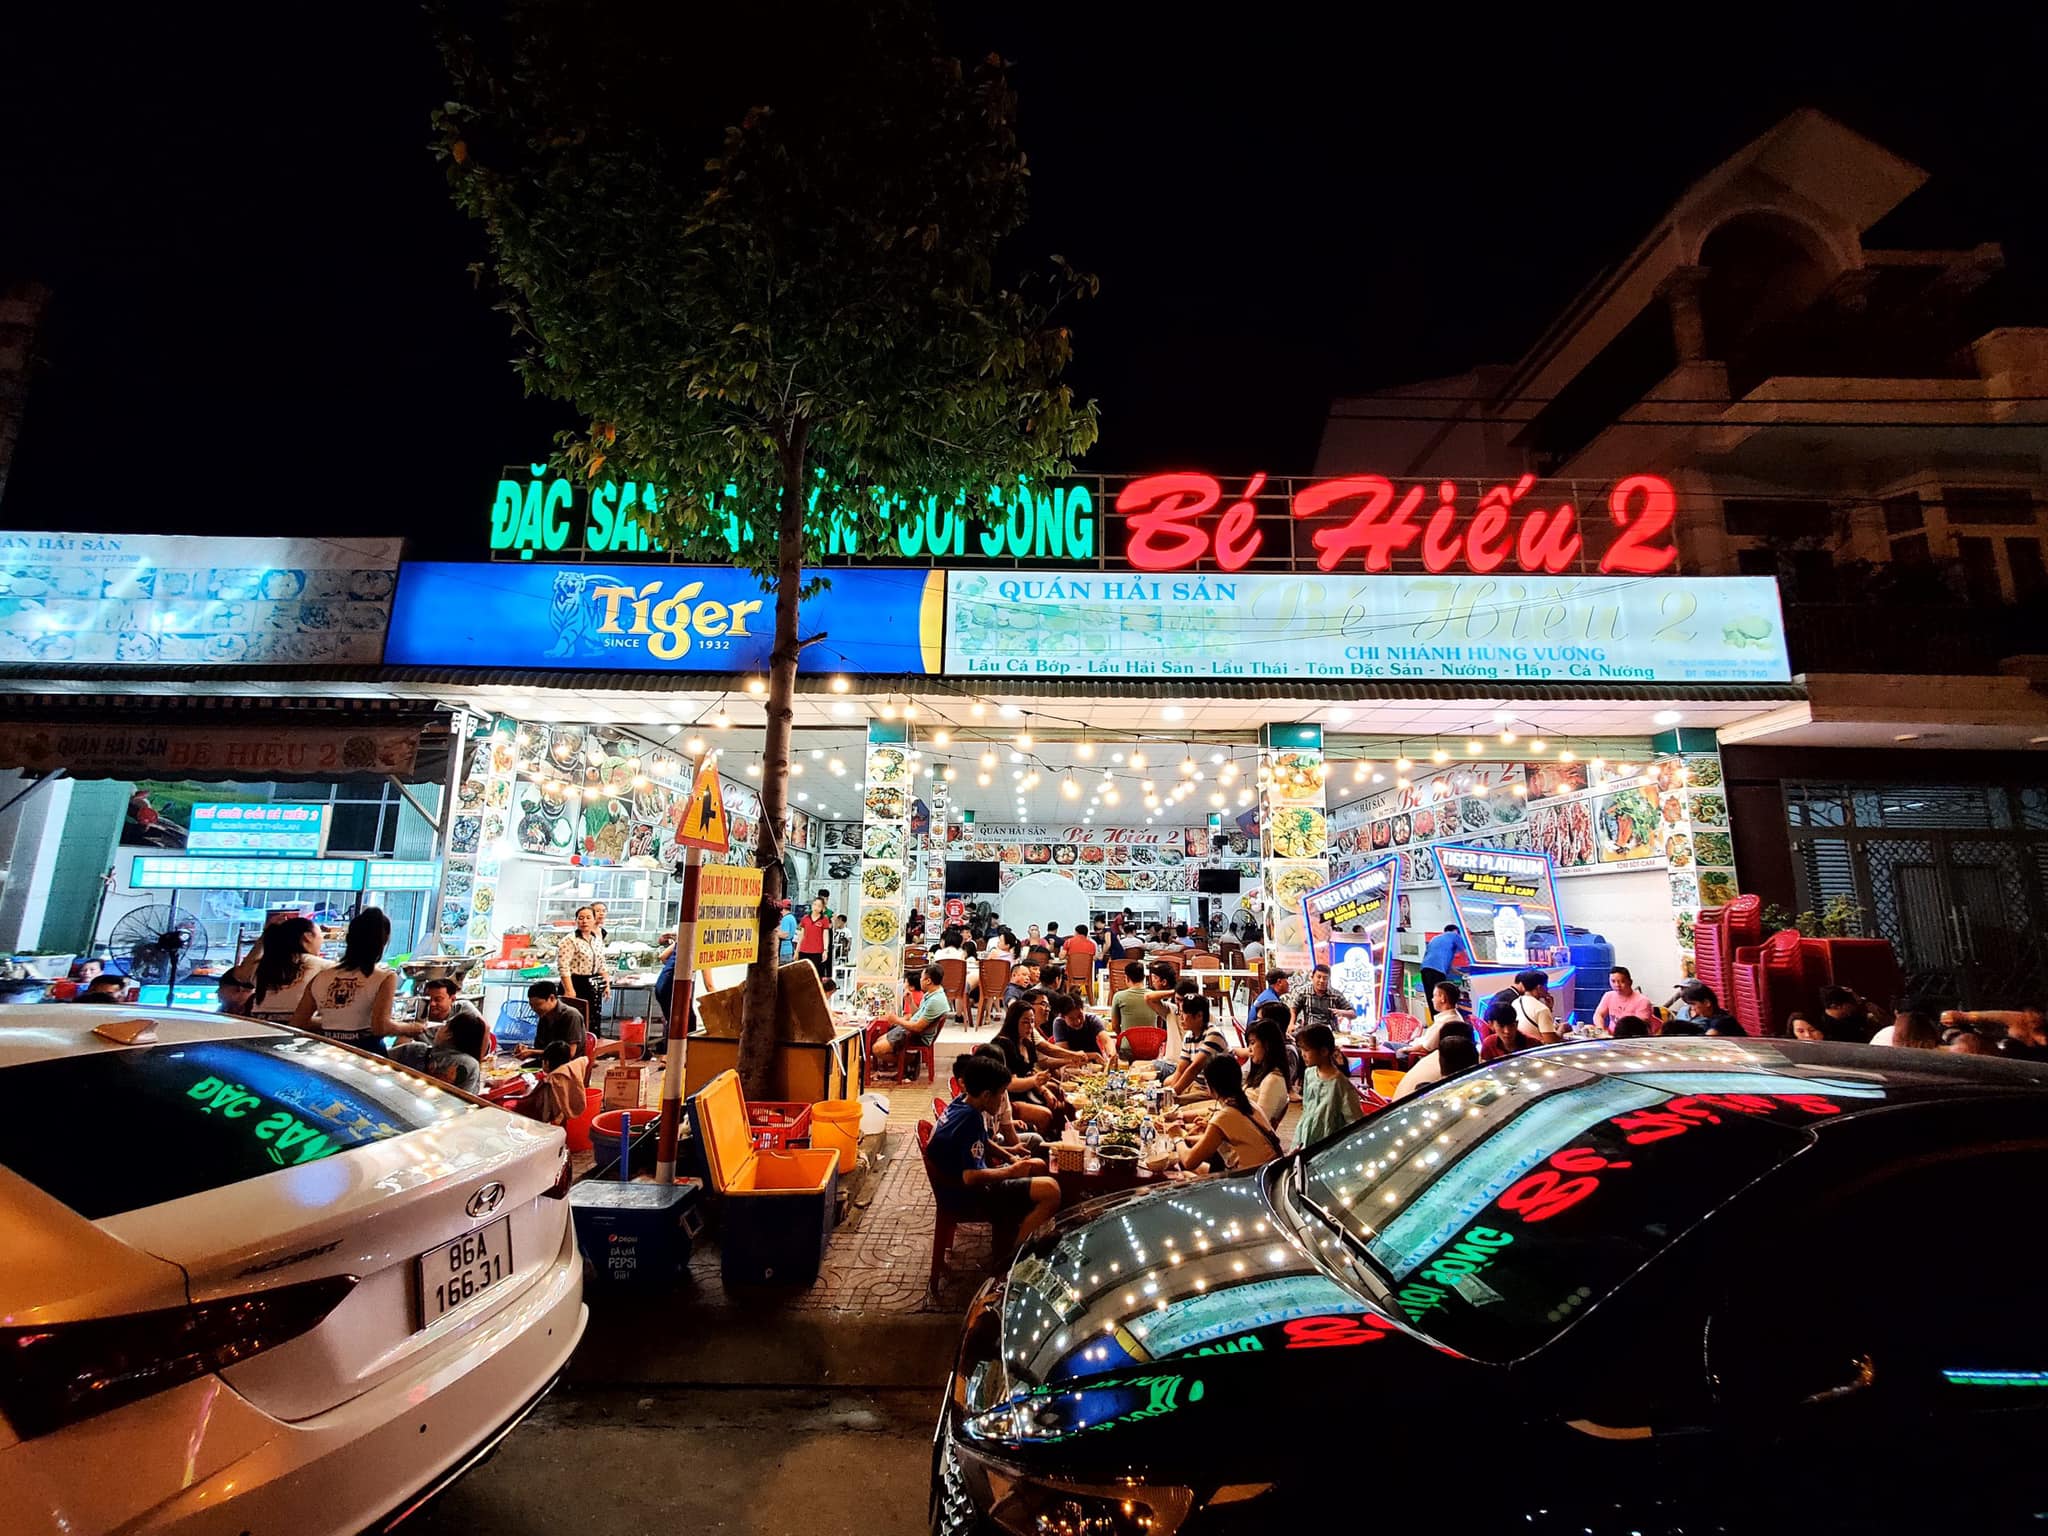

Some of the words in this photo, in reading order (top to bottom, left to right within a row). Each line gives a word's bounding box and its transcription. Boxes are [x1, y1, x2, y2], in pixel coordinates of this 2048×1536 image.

[490, 463, 573, 560] ĐẶC
[1115, 471, 1267, 572] Bé
[1293, 473, 1583, 573] Hiếu
[1599, 473, 1678, 573] 2
[999, 576, 1091, 602] QUÁN
[1103, 576, 1162, 600] HẢI
[1172, 576, 1237, 601] SẢN
[592, 581, 763, 661] Tiger
[1651, 591, 1698, 642] 2
[604, 638, 640, 648] SINCE
[699, 640, 730, 650] 1932
[1345, 646, 1379, 660] CHI
[1393, 643, 1461, 661] NHÁNH
[1469, 642, 1527, 661] HÙNG
[1533, 645, 1606, 661] VƯƠNG
[968, 658, 1000, 672] Lẩu
[1006, 659, 1029, 672] Cá
[1036, 659, 1071, 675] Bớp
[1088, 659, 1120, 673] Lẩu
[1126, 660, 1155, 674] Hải
[1162, 660, 1194, 674] Sản
[1211, 660, 1244, 675] Lẩu
[1250, 661, 1288, 675] Thái
[1305, 661, 1344, 676] Tôm
[1351, 662, 1384, 678] Đặc
[1390, 661, 1424, 676] Sản
[1442, 662, 1498, 679] Nướng
[1516, 661, 1552, 679] Hấp
[1569, 662, 1592, 677] Cá
[1599, 663, 1655, 680] Nướng
[319, 743, 337, 768] 2
[1063, 826, 1095, 843] Bé
[1166, 830, 1179, 844] 2
[1441, 851, 1477, 868] TIGER
[1480, 854, 1544, 875] PLATINUM
[450, 1232, 488, 1272] 86A
[609, 1257, 637, 1269] PEPSI
[436, 1254, 501, 1313] 166.31
